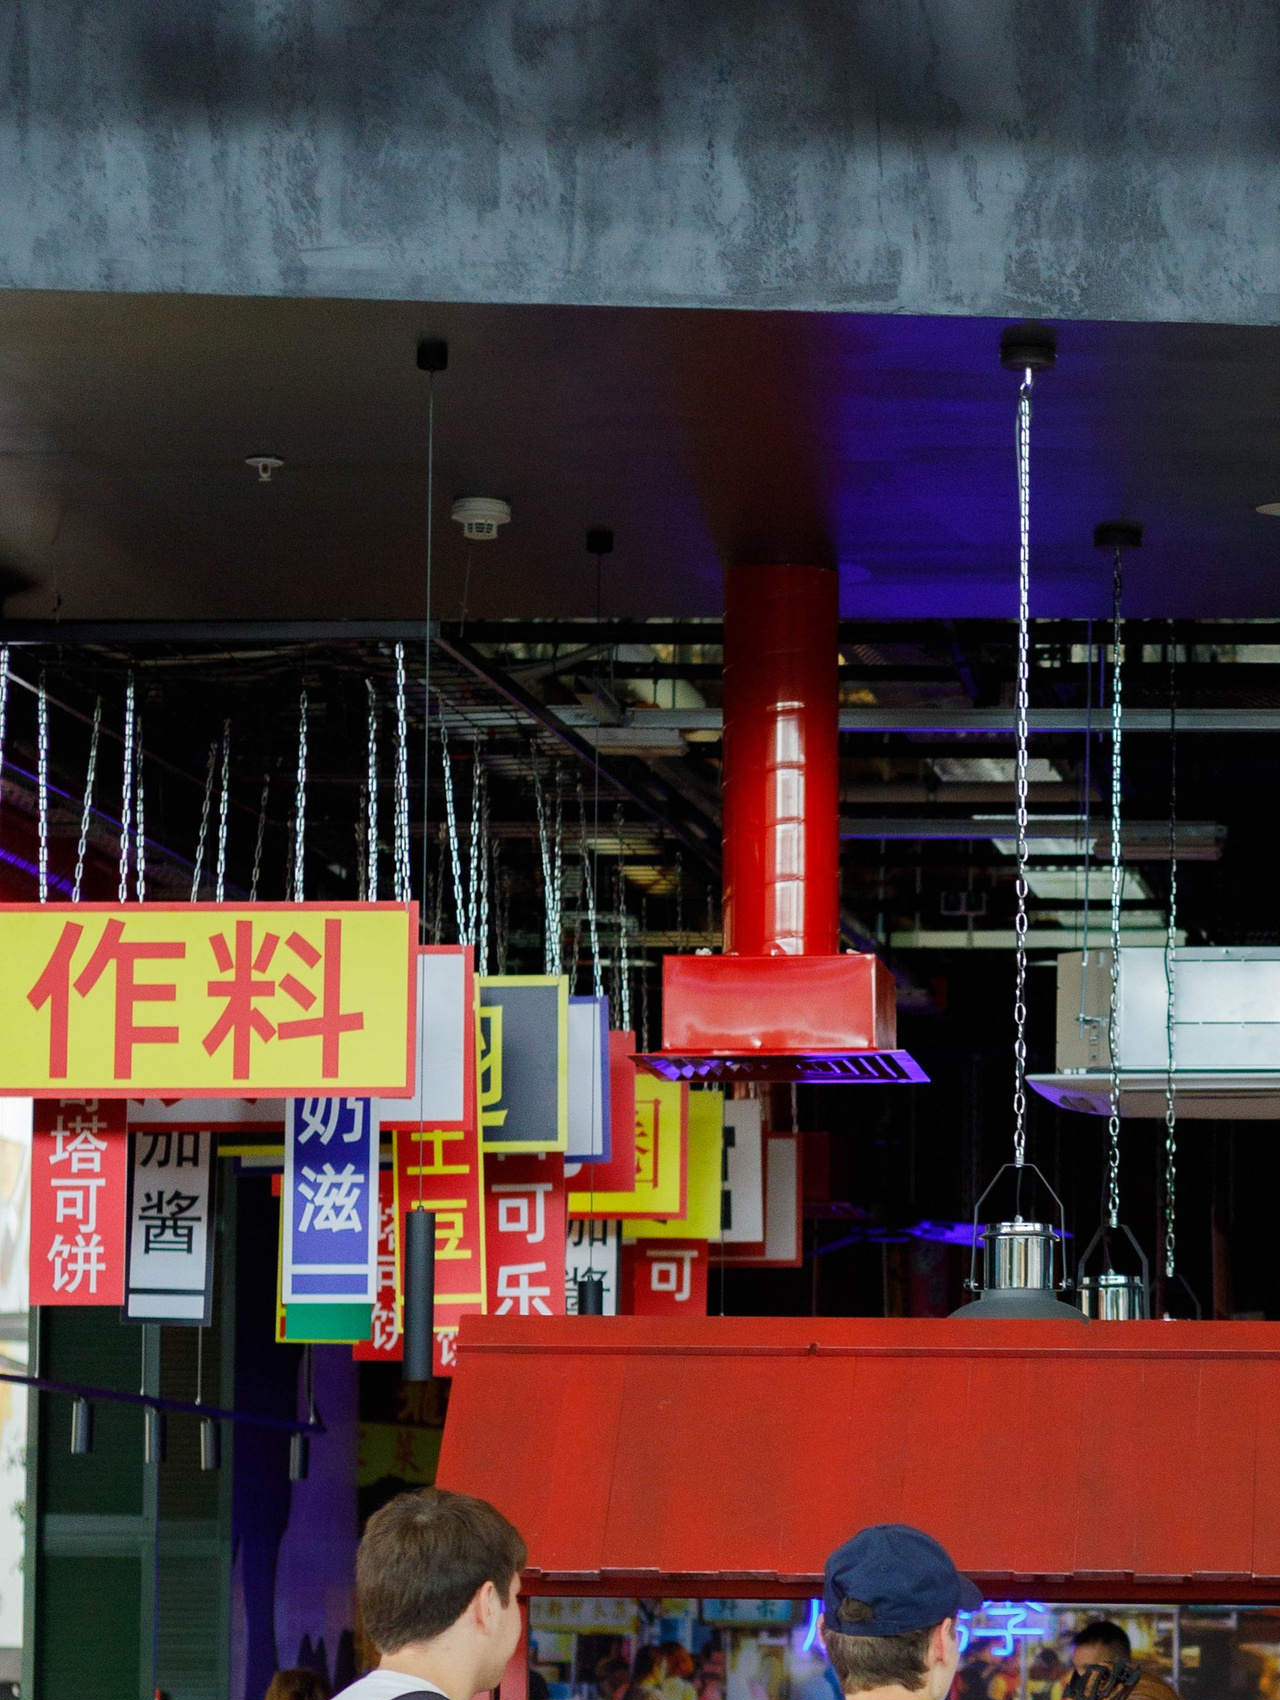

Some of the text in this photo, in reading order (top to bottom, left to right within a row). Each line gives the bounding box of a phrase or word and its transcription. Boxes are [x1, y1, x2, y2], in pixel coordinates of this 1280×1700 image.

[27, 917, 365, 1080] 作料
[47, 1098, 108, 1293] 塔可饼
[491, 1152, 554, 1316] 可乐
